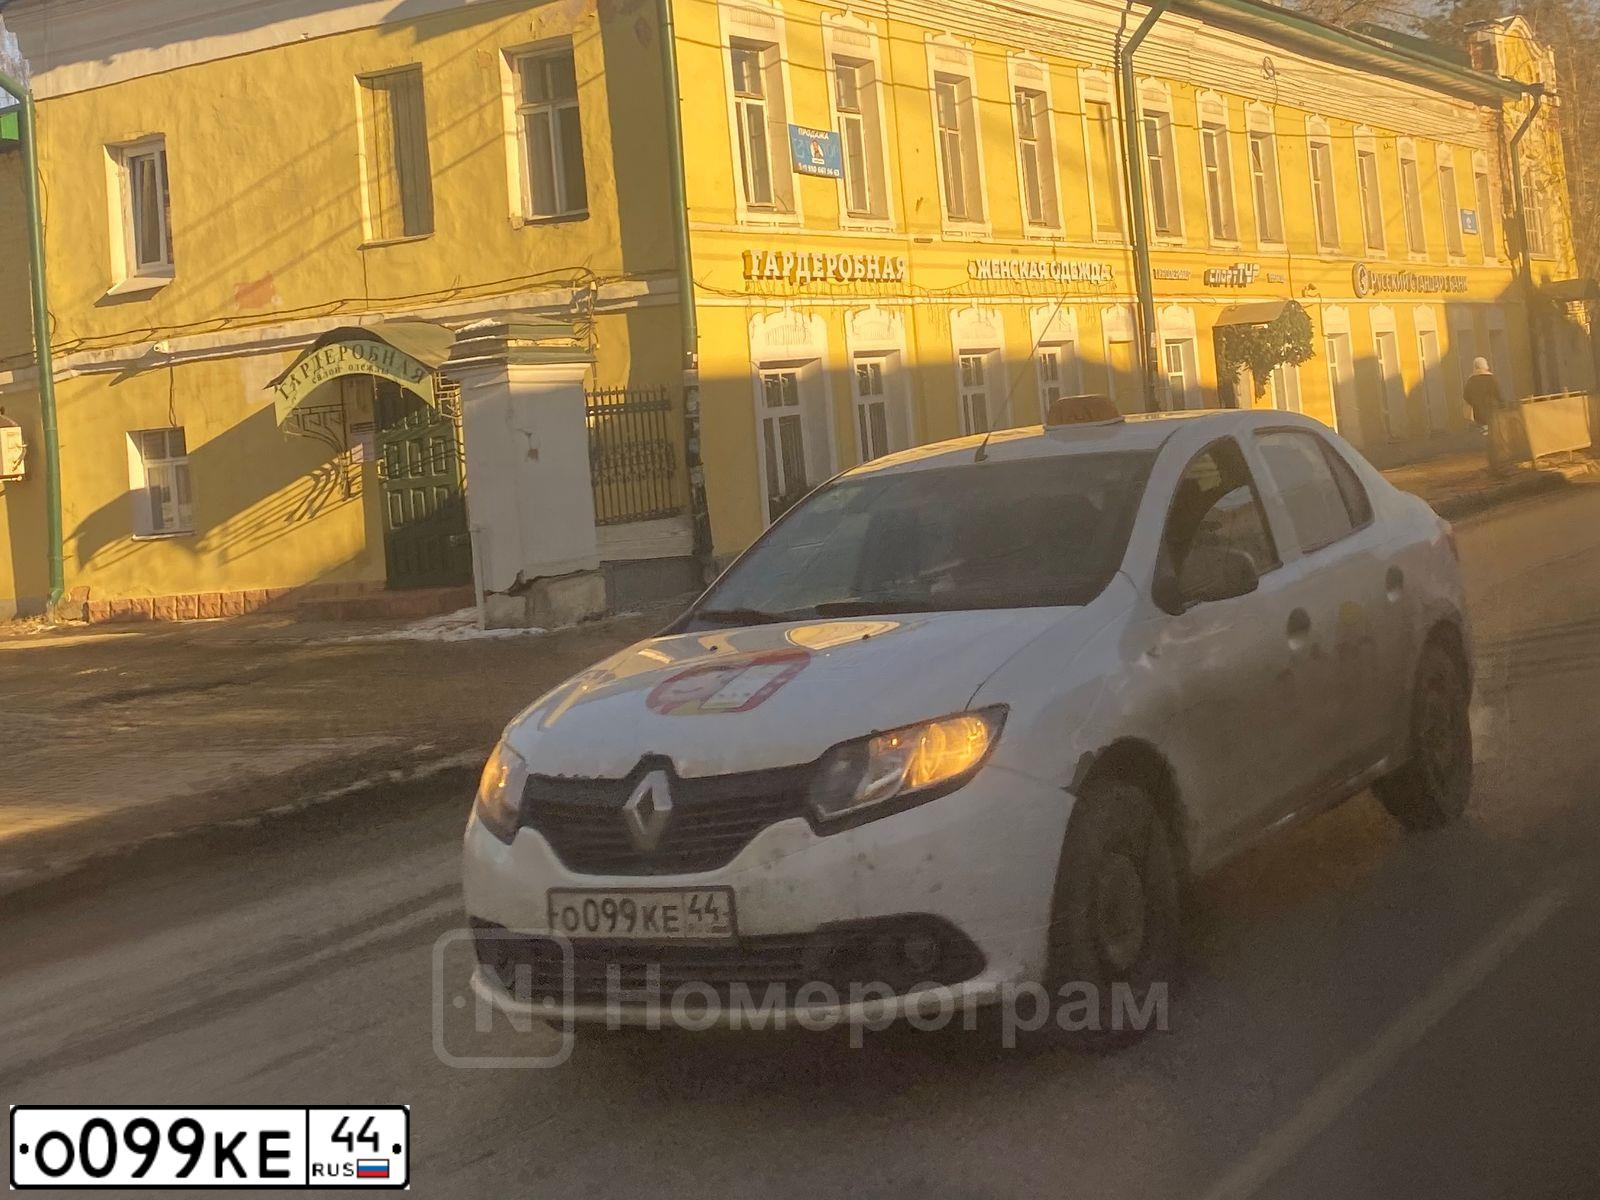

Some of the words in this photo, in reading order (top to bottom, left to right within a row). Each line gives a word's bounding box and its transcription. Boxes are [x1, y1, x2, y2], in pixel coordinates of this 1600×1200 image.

[745, 249, 908, 285] ГАРДЕРОБНАЯ
[970, 258, 1049, 281] ЖЕНСКАЯ
[1050, 260, 1113, 285] ОДЕЖДА
[276, 343, 425, 400] ГАРДЕРОБНАЯ
[561, 897, 679, 933] О099КЕ
[688, 893, 719, 921] 44
